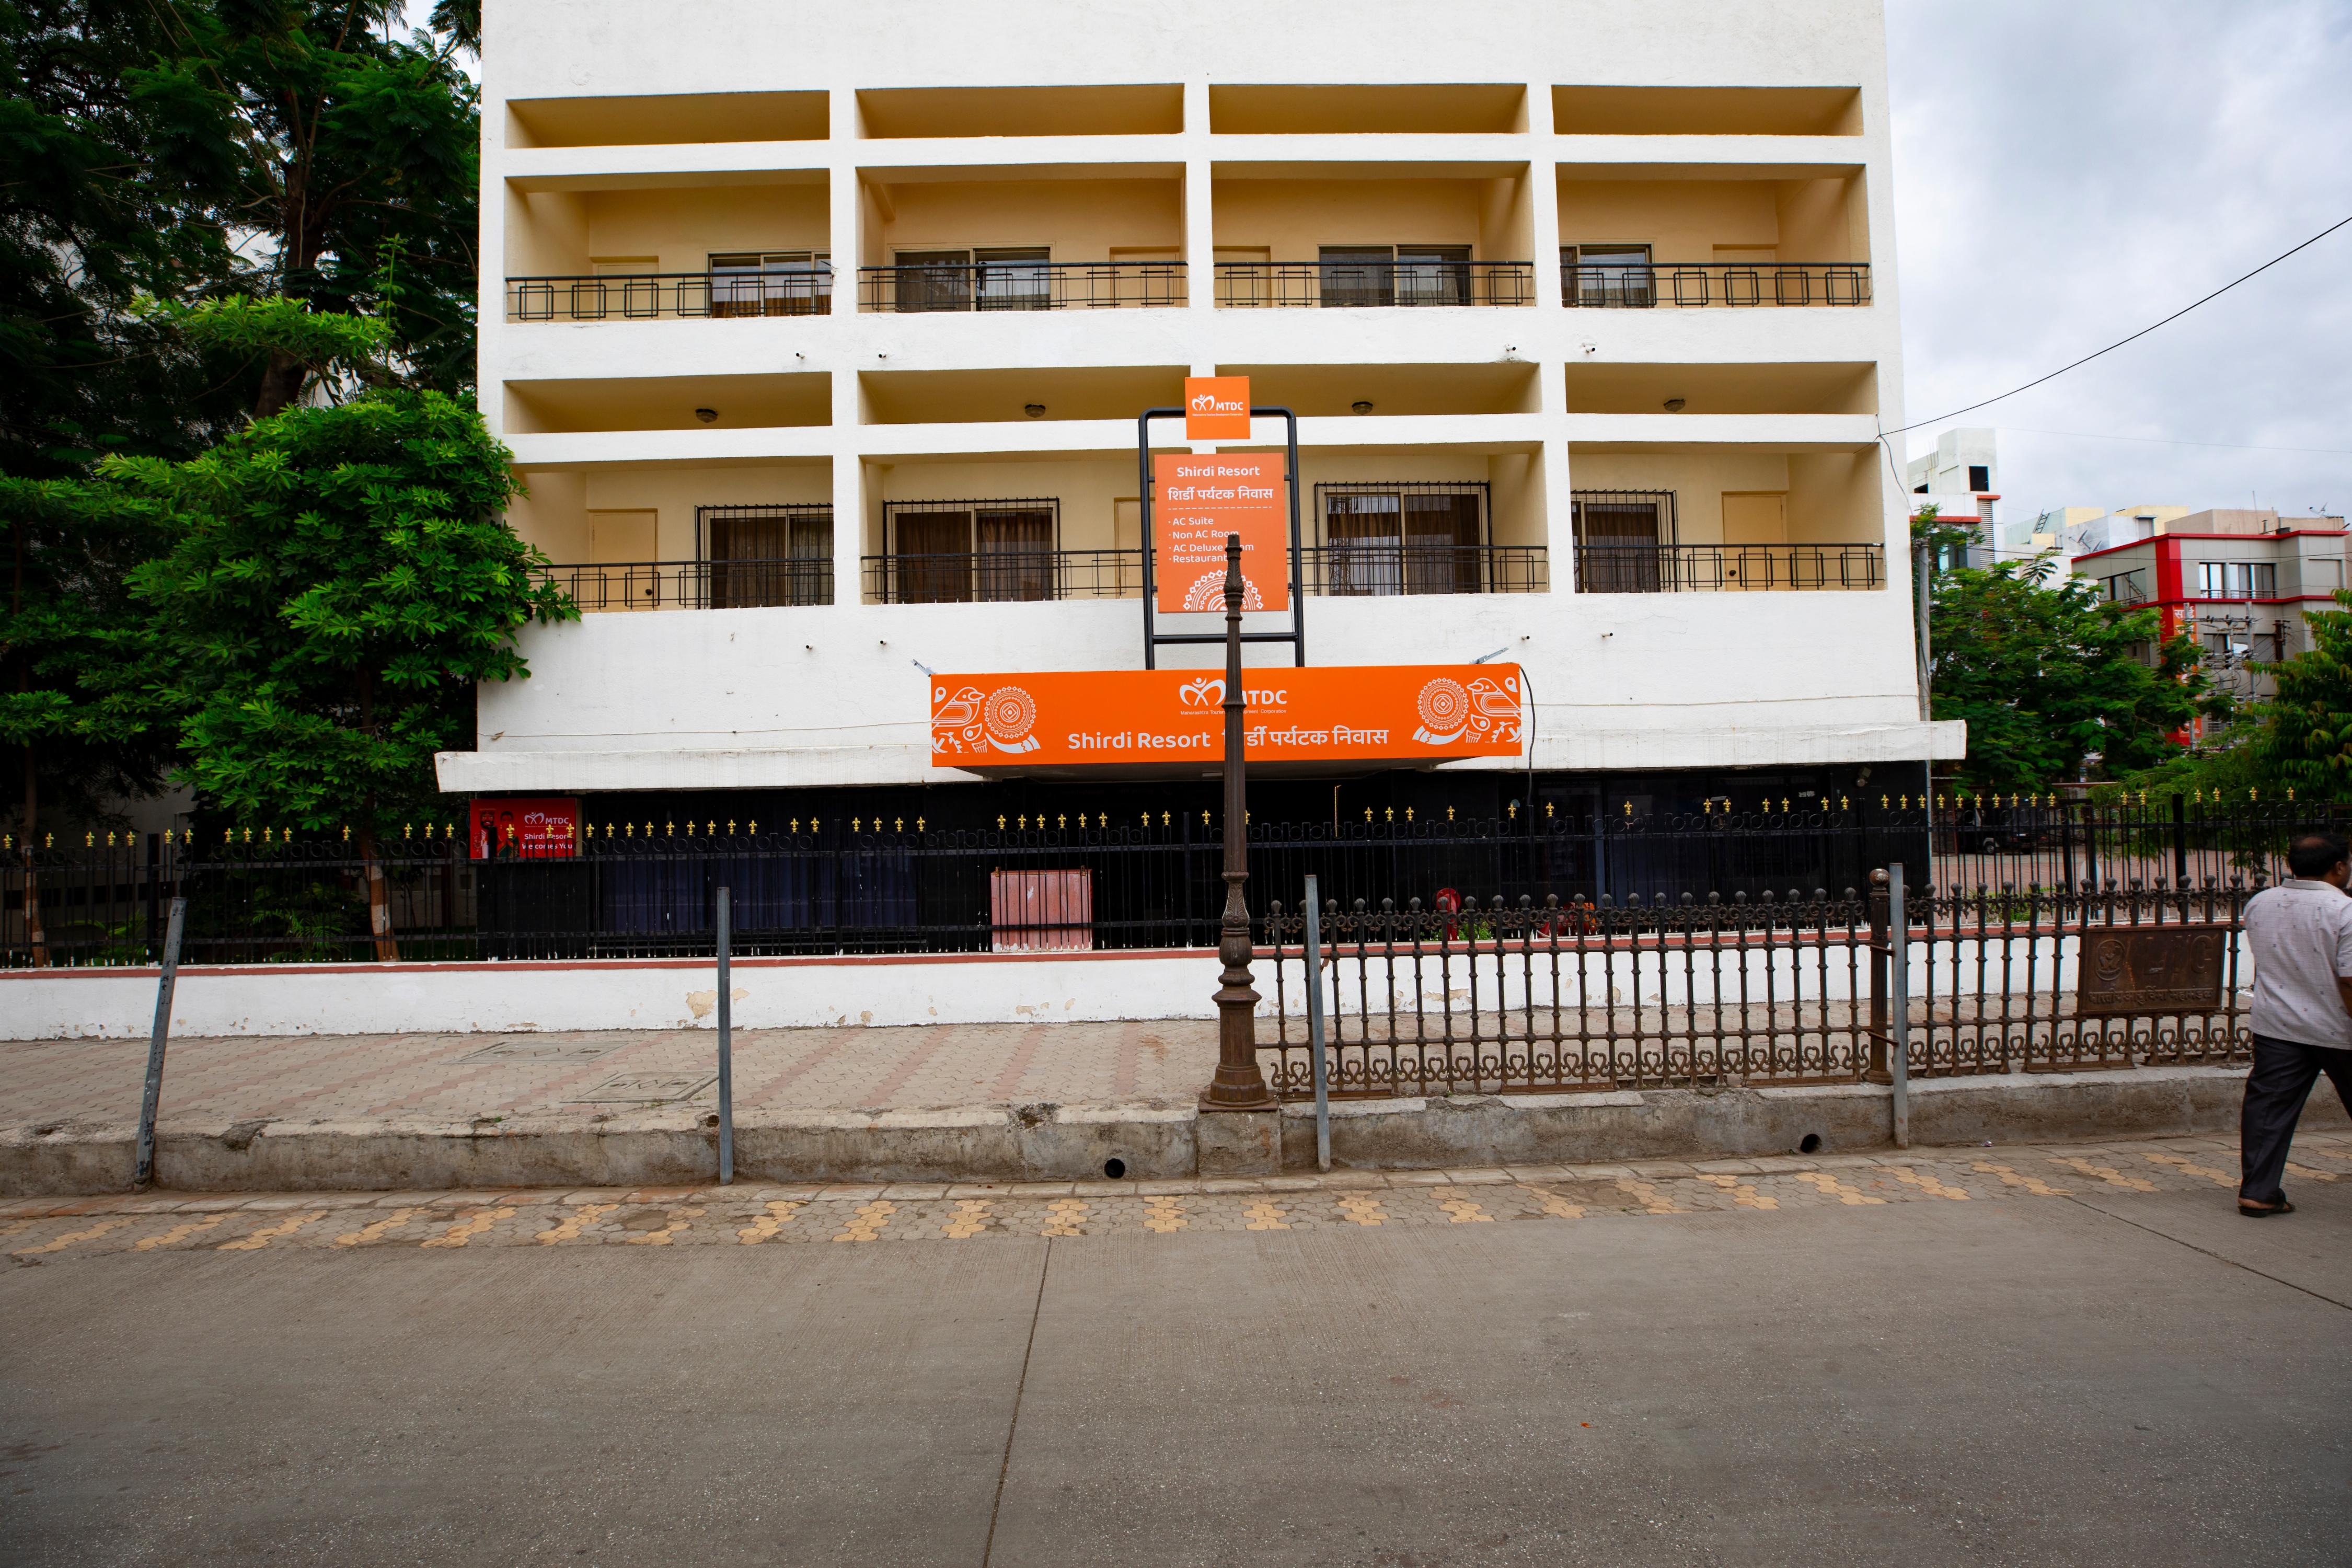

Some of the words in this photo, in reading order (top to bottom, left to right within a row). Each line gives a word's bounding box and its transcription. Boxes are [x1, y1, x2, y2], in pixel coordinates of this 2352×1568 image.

[1216, 401, 1243, 411] MTDC
[1177, 466, 1214, 477] Shirdi
[1217, 466, 1260, 476] Resort
[1168, 487, 1195, 500] शिर्डी
[1197, 486, 1235, 499] पर्यटक
[1237, 486, 1274, 499] निवास
[1189, 516, 1214, 525] Suite
[1190, 544, 1223, 552] Deluxe
[1173, 555, 1227, 563] Restaurant
[1068, 731, 1132, 749] Shirdi
[1138, 732, 1211, 748] Resort
[1269, 725, 1329, 746] पर्यटक
[1332, 725, 1389, 745] निवास
